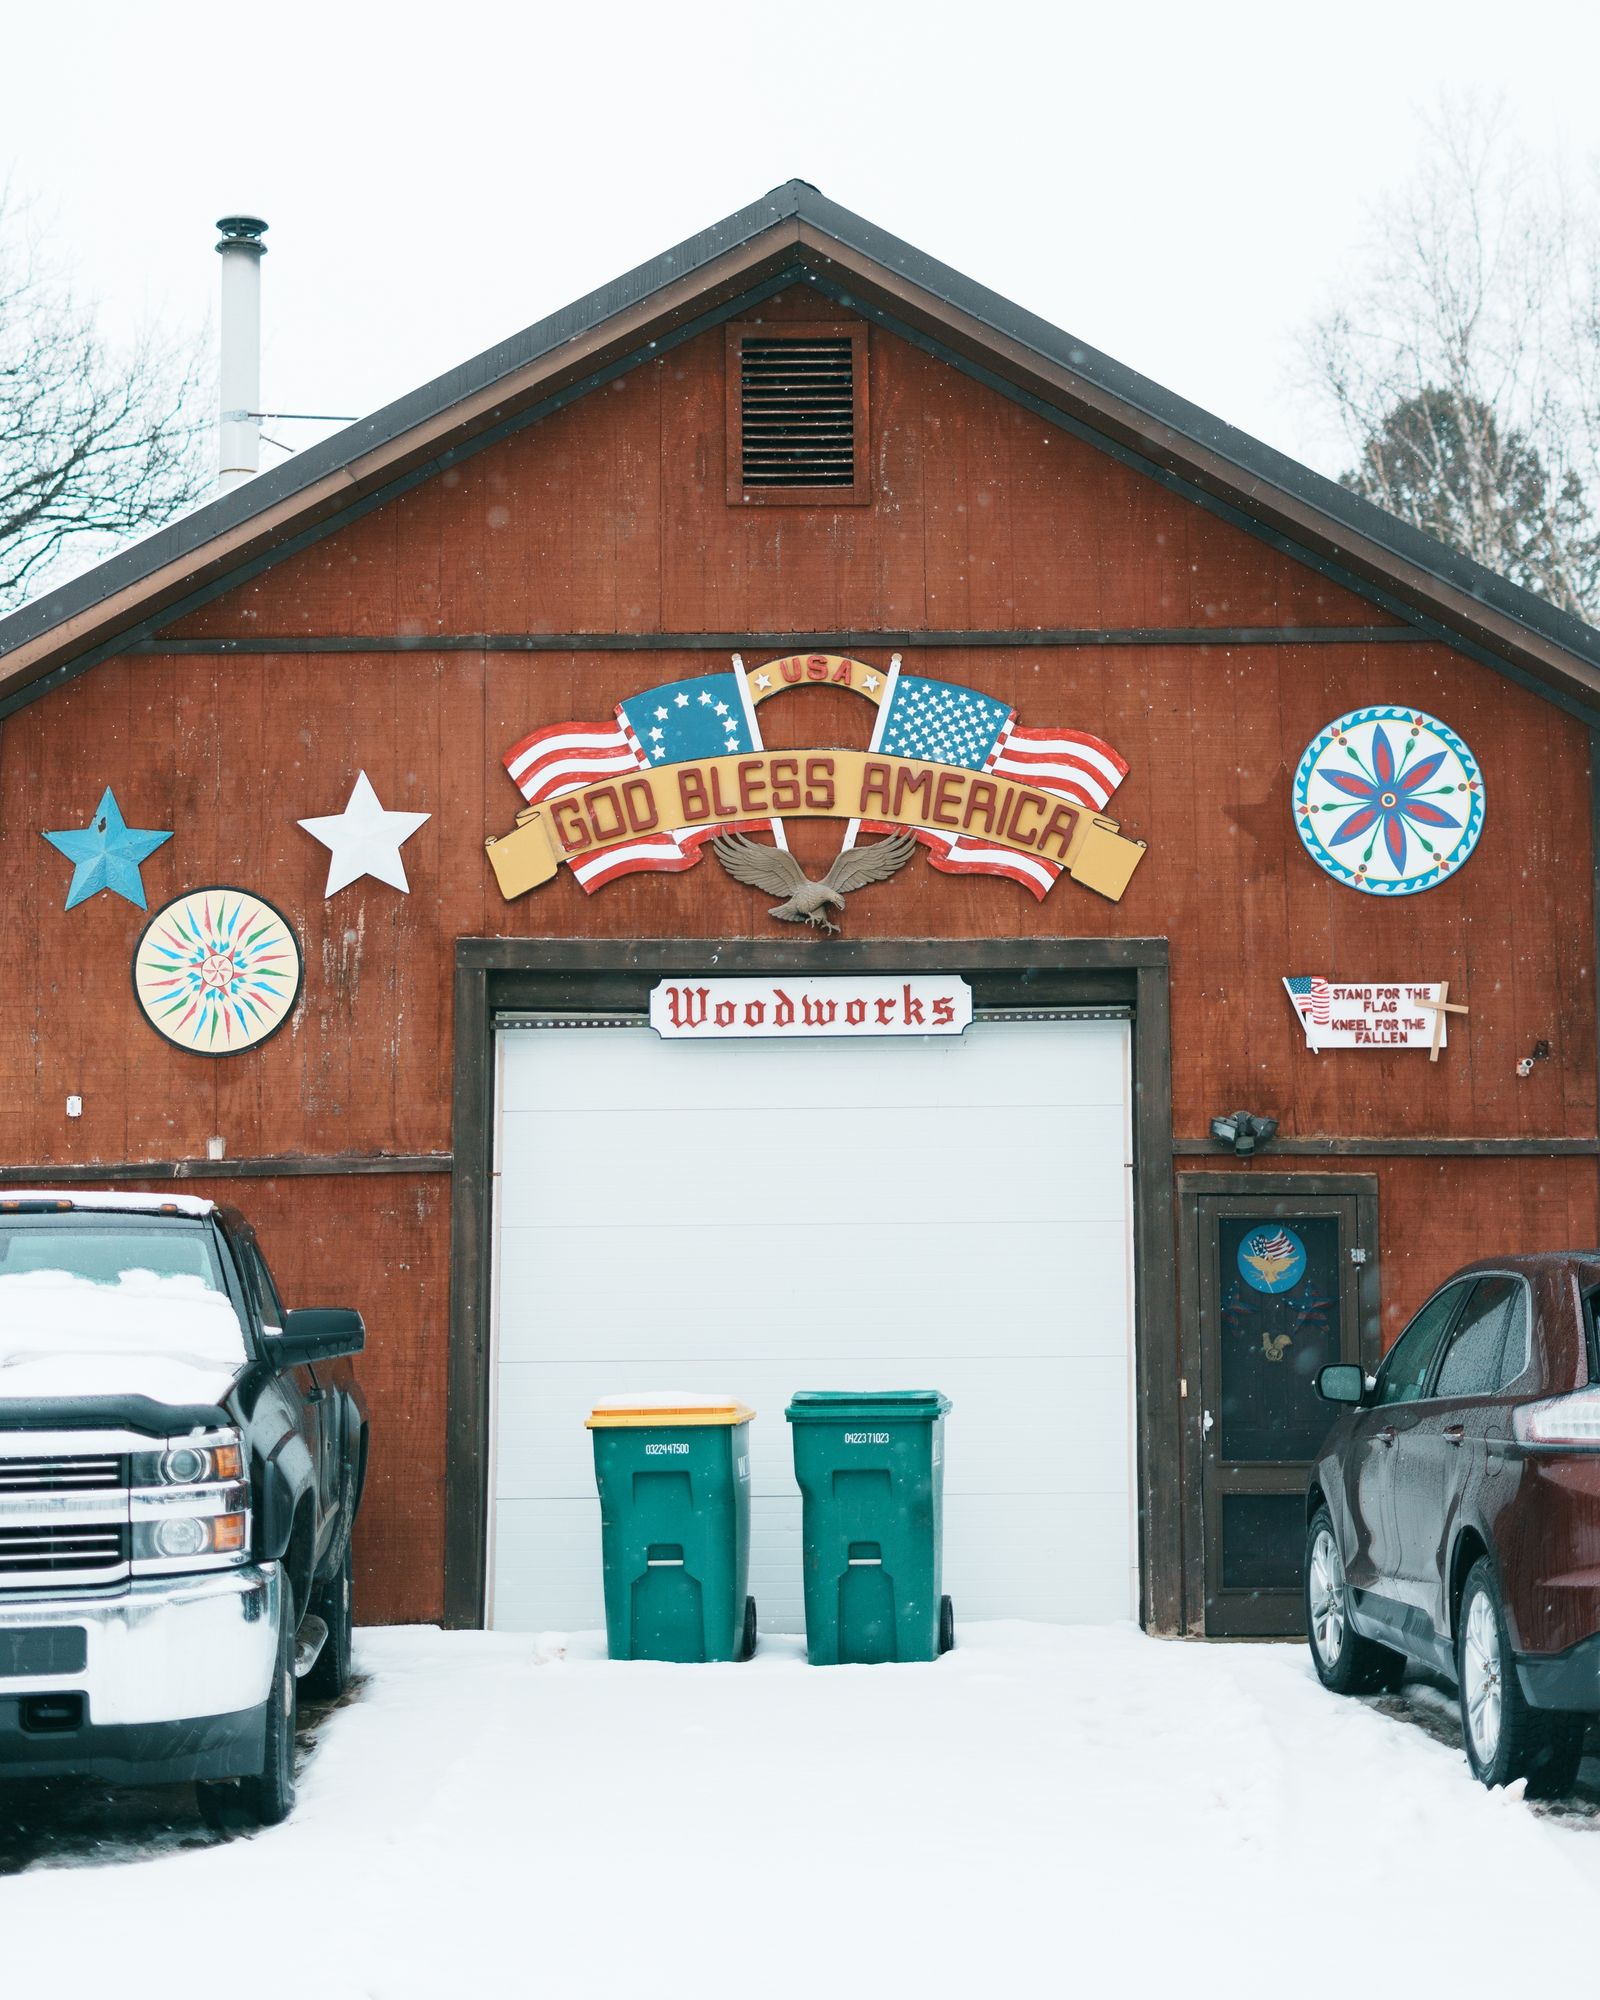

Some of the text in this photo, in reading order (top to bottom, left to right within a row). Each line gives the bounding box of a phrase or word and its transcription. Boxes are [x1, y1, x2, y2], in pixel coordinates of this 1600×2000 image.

[780, 655, 852, 685] USA
[550, 758, 1080, 858] GOD BLESS AMERICA
[1332, 988, 1431, 1001] STAND FOR THE
[665, 983, 956, 1028] Woodworks
[1363, 1001, 1398, 1013] FLAG
[1331, 1018, 1426, 1031] KNEEL FOR THE
[1354, 1031, 1408, 1044] FALLEN
[844, 1432, 890, 1444] 0422371023
[645, 1443, 690, 1455] 0322447500
